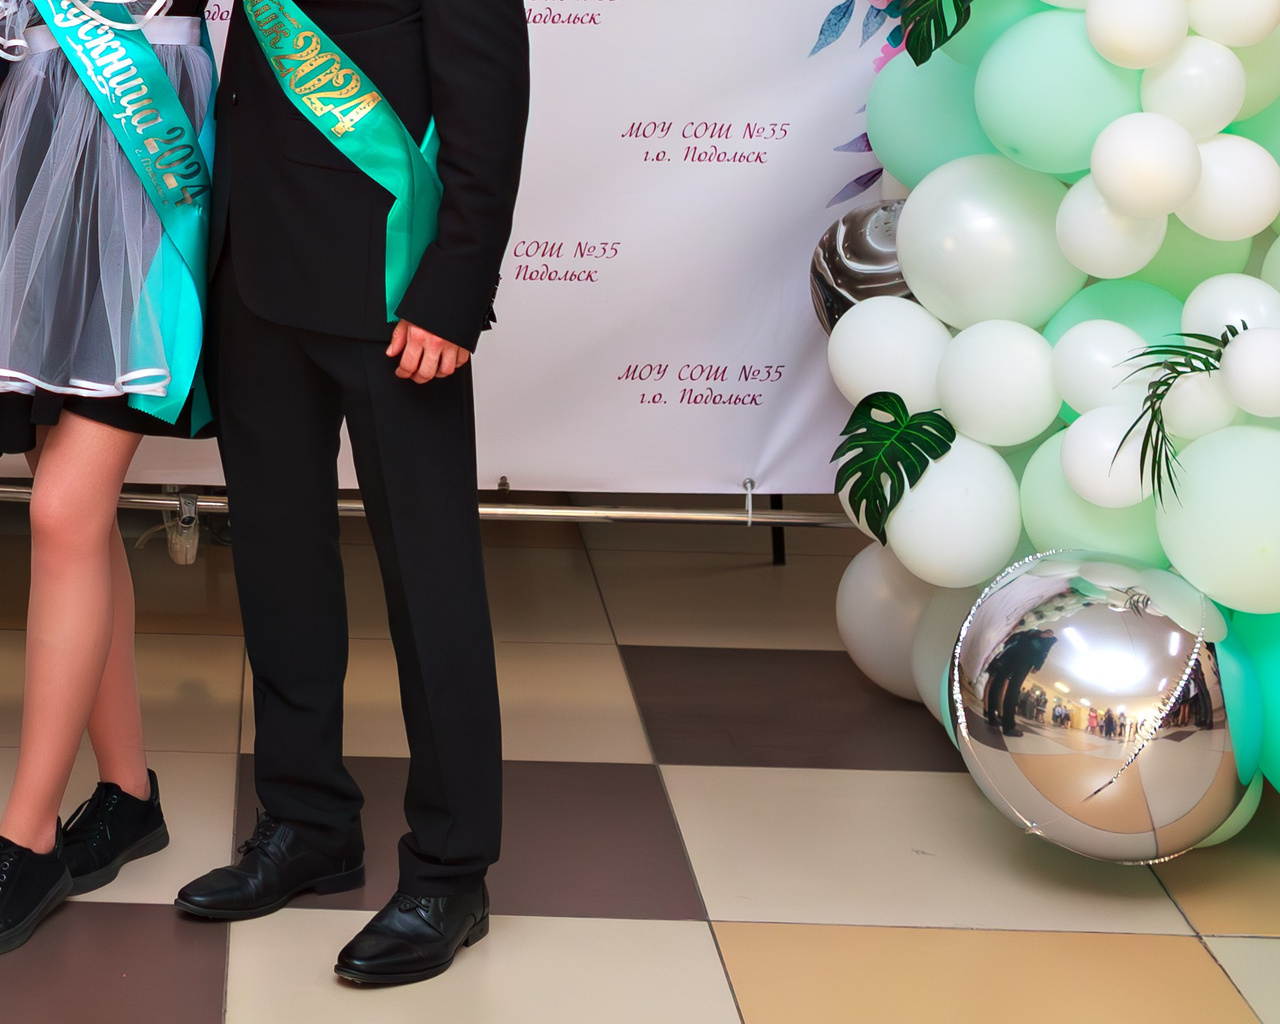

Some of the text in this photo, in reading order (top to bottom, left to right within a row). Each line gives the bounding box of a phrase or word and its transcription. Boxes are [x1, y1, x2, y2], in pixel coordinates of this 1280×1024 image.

[270, 30, 382, 138] 2024
[620, 121, 790, 140] МОУ СОШ №35
[643, 144, 768, 164] г.о. Подольск
[143, 126, 208, 208] 2024
[513, 240, 621, 260] СОШ №35
[514, 263, 599, 283] Подольск
[617, 363, 785, 382] МОУ СОШ №35
[639, 387, 763, 406] г.о. Подольск
